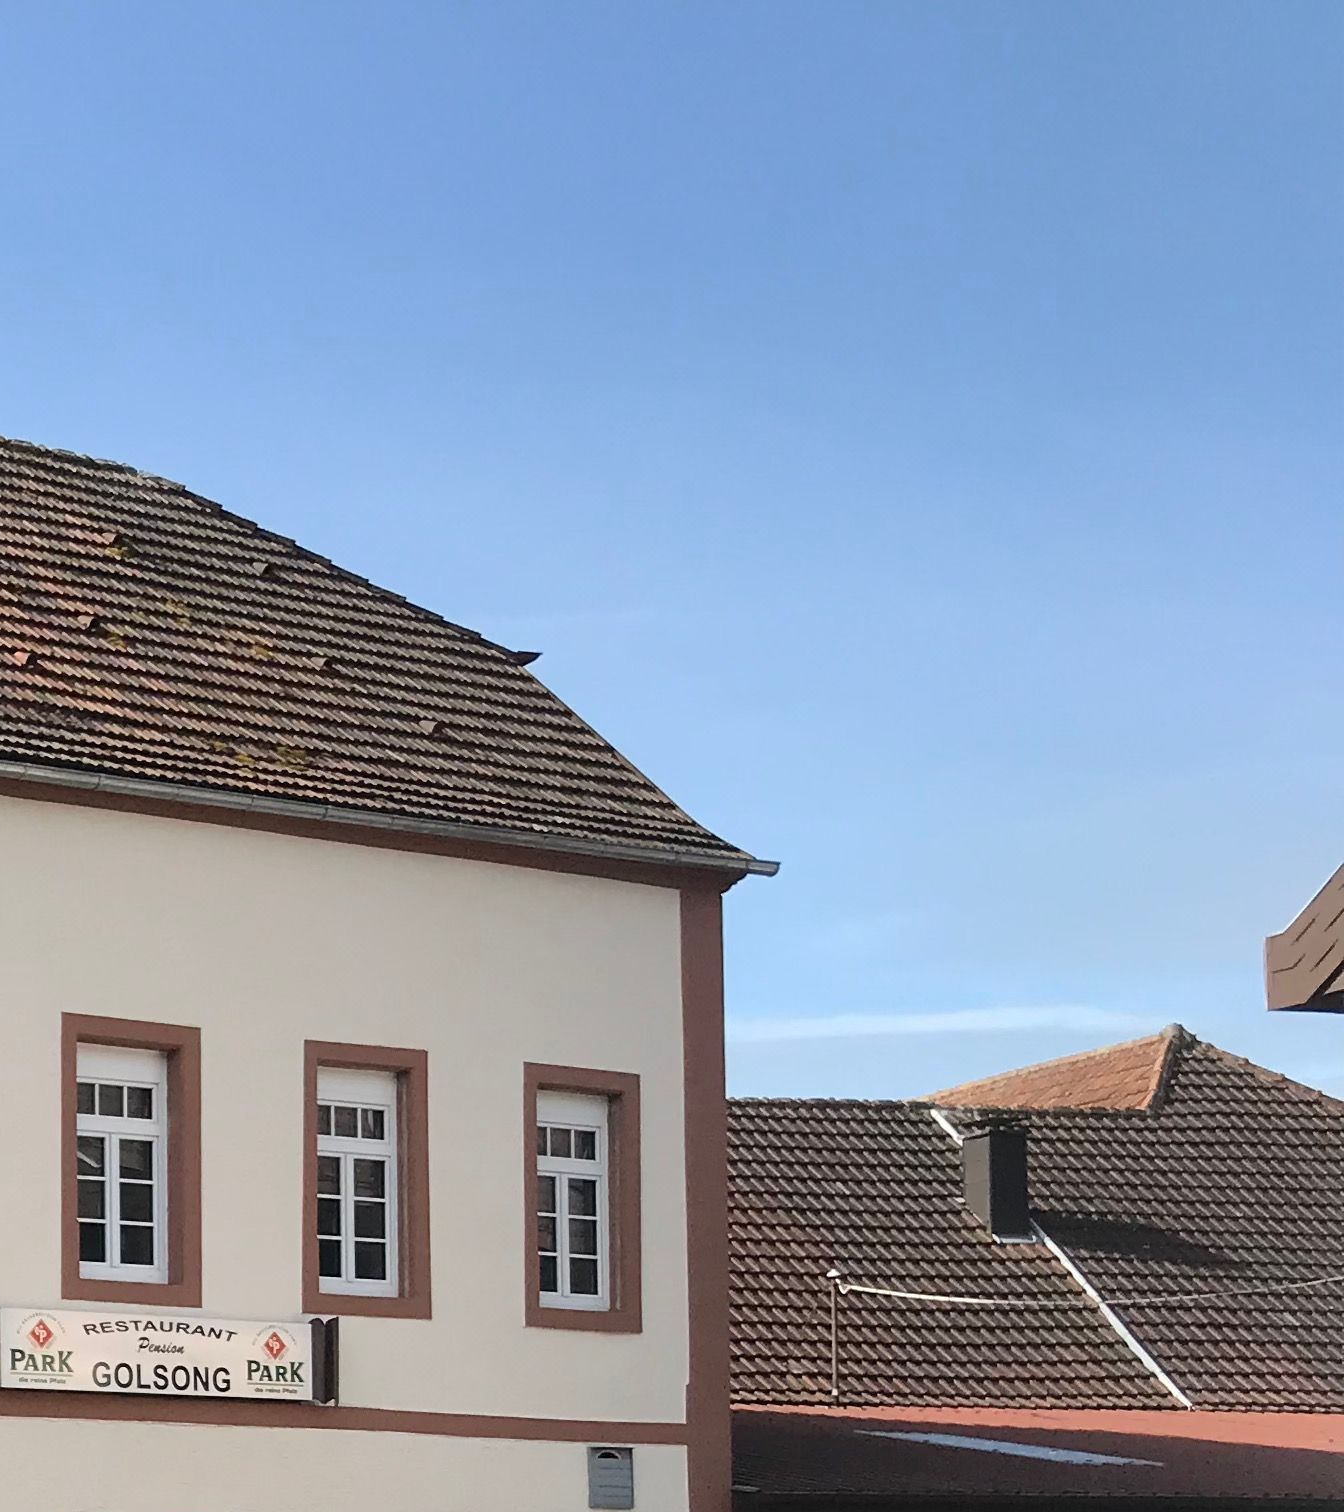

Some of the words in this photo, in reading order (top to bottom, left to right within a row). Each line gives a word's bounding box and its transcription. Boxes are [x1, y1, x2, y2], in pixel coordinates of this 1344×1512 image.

[83, 1320, 238, 1342] RESTAURANT
[137, 1336, 185, 1355] Pension
[9, 1348, 74, 1373] PARK
[246, 1360, 305, 1383] PARK
[92, 1361, 231, 1393] GOLSONG
